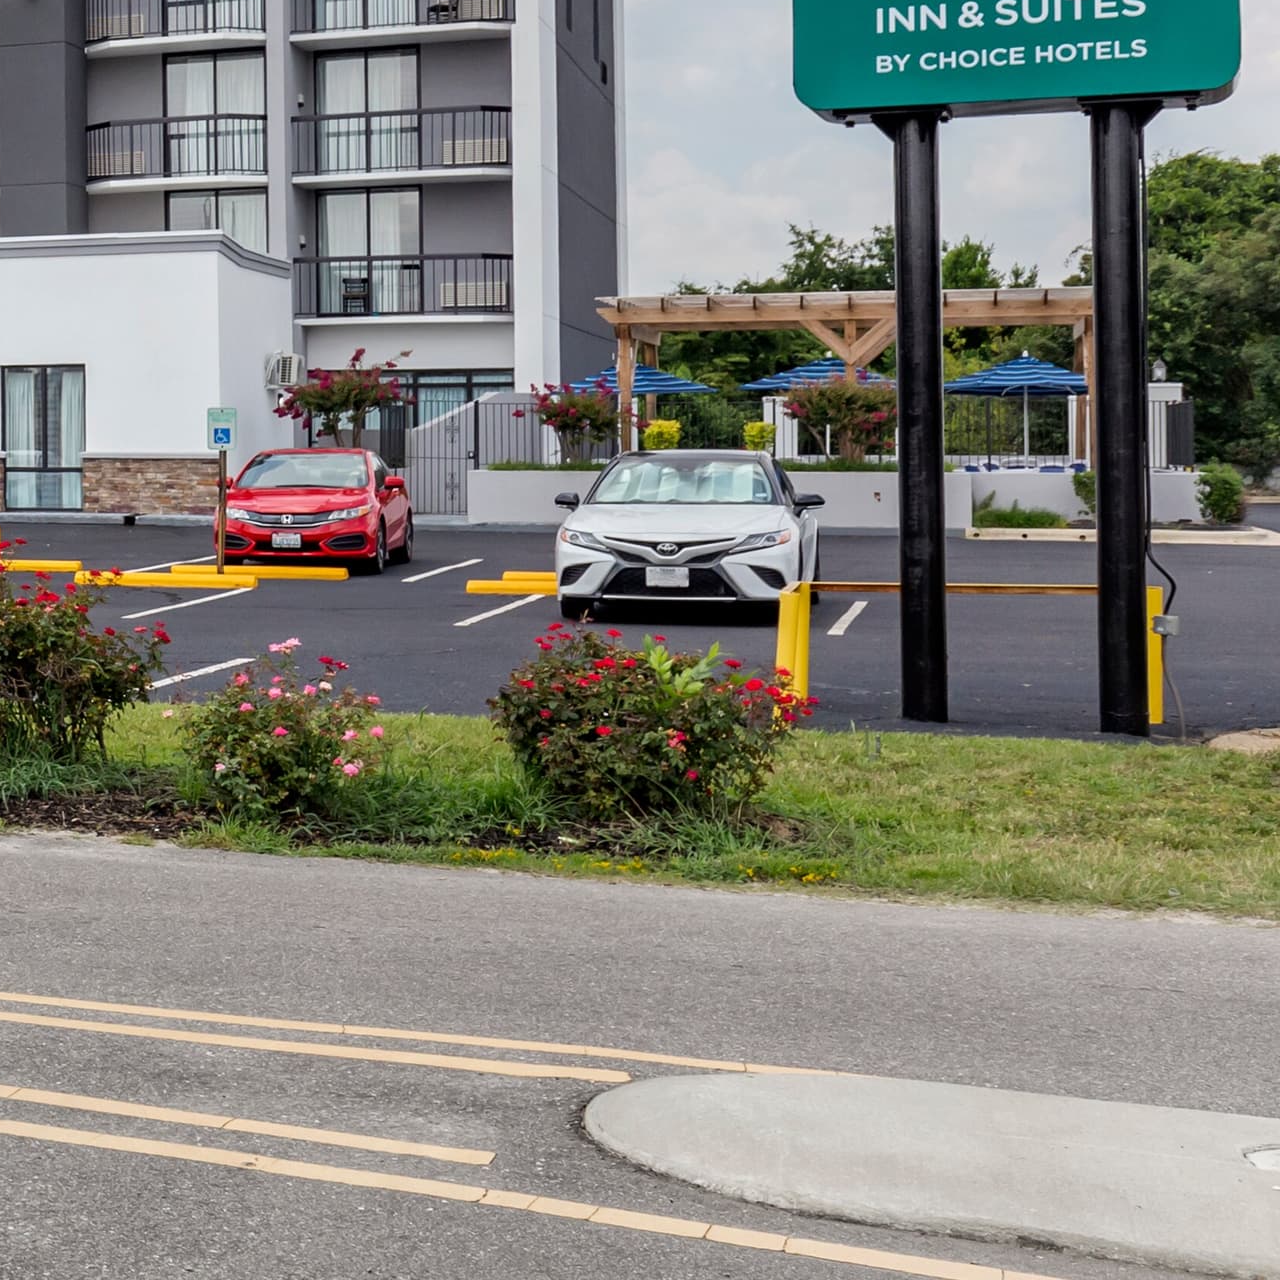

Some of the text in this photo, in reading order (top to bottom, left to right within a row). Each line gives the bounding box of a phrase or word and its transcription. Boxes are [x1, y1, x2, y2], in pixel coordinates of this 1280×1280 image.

[876, 3, 947, 34] INN
[957, 1, 985, 28] &
[876, 38, 1148, 74] BY CHOICE HOTELS
